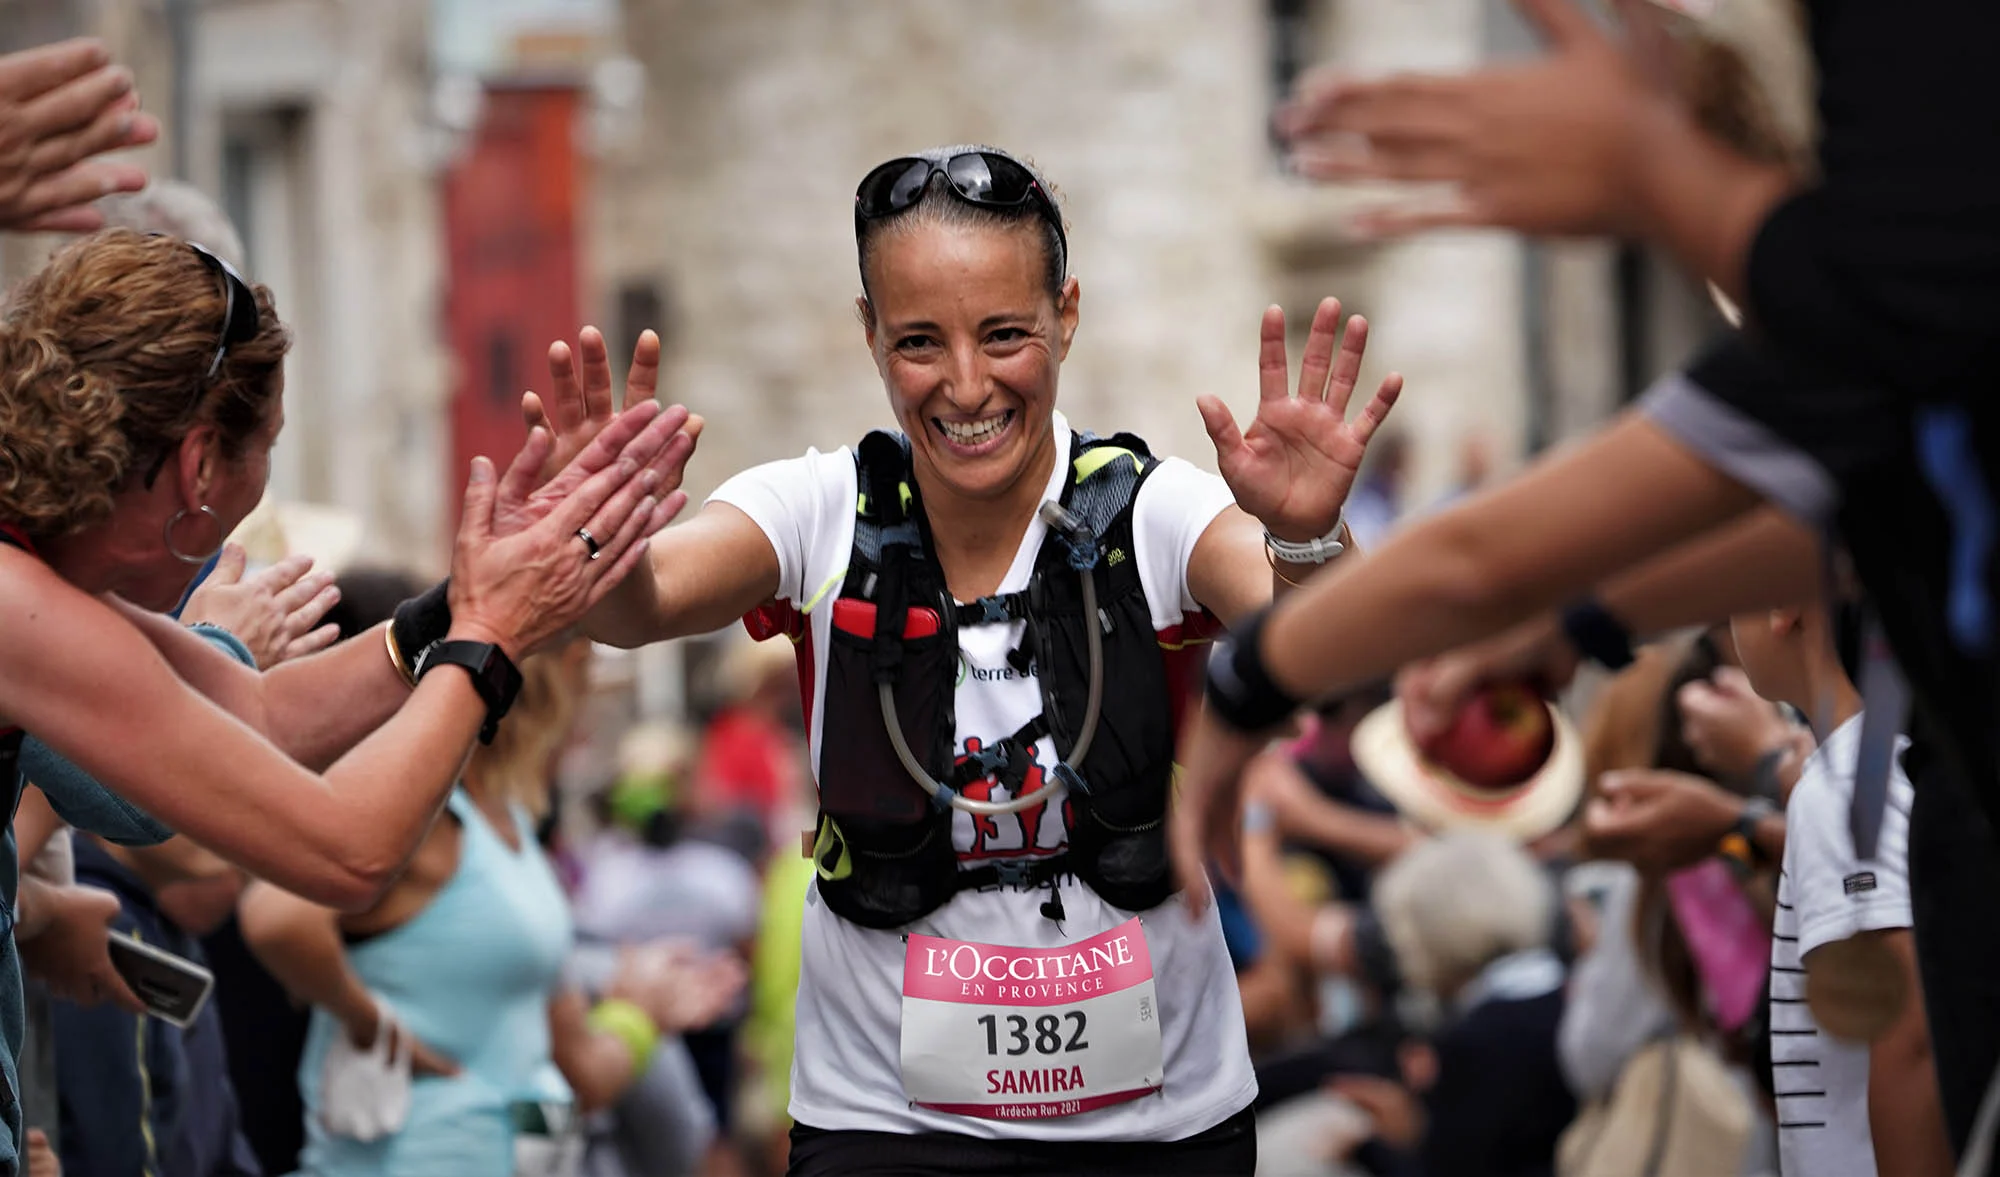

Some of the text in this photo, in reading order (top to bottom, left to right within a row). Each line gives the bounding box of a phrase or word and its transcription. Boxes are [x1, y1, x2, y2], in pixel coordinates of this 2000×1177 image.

[971, 664, 1013, 681] terre
[924, 935, 1133, 981] L'OCCITANE
[961, 977, 1104, 999] EN PROVENCE
[977, 1010, 1089, 1056] 1382
[986, 1065, 1085, 1094] SAMIRA
[1040, 1103, 1058, 1116] Run
[1061, 1100, 1080, 1115] 2021
